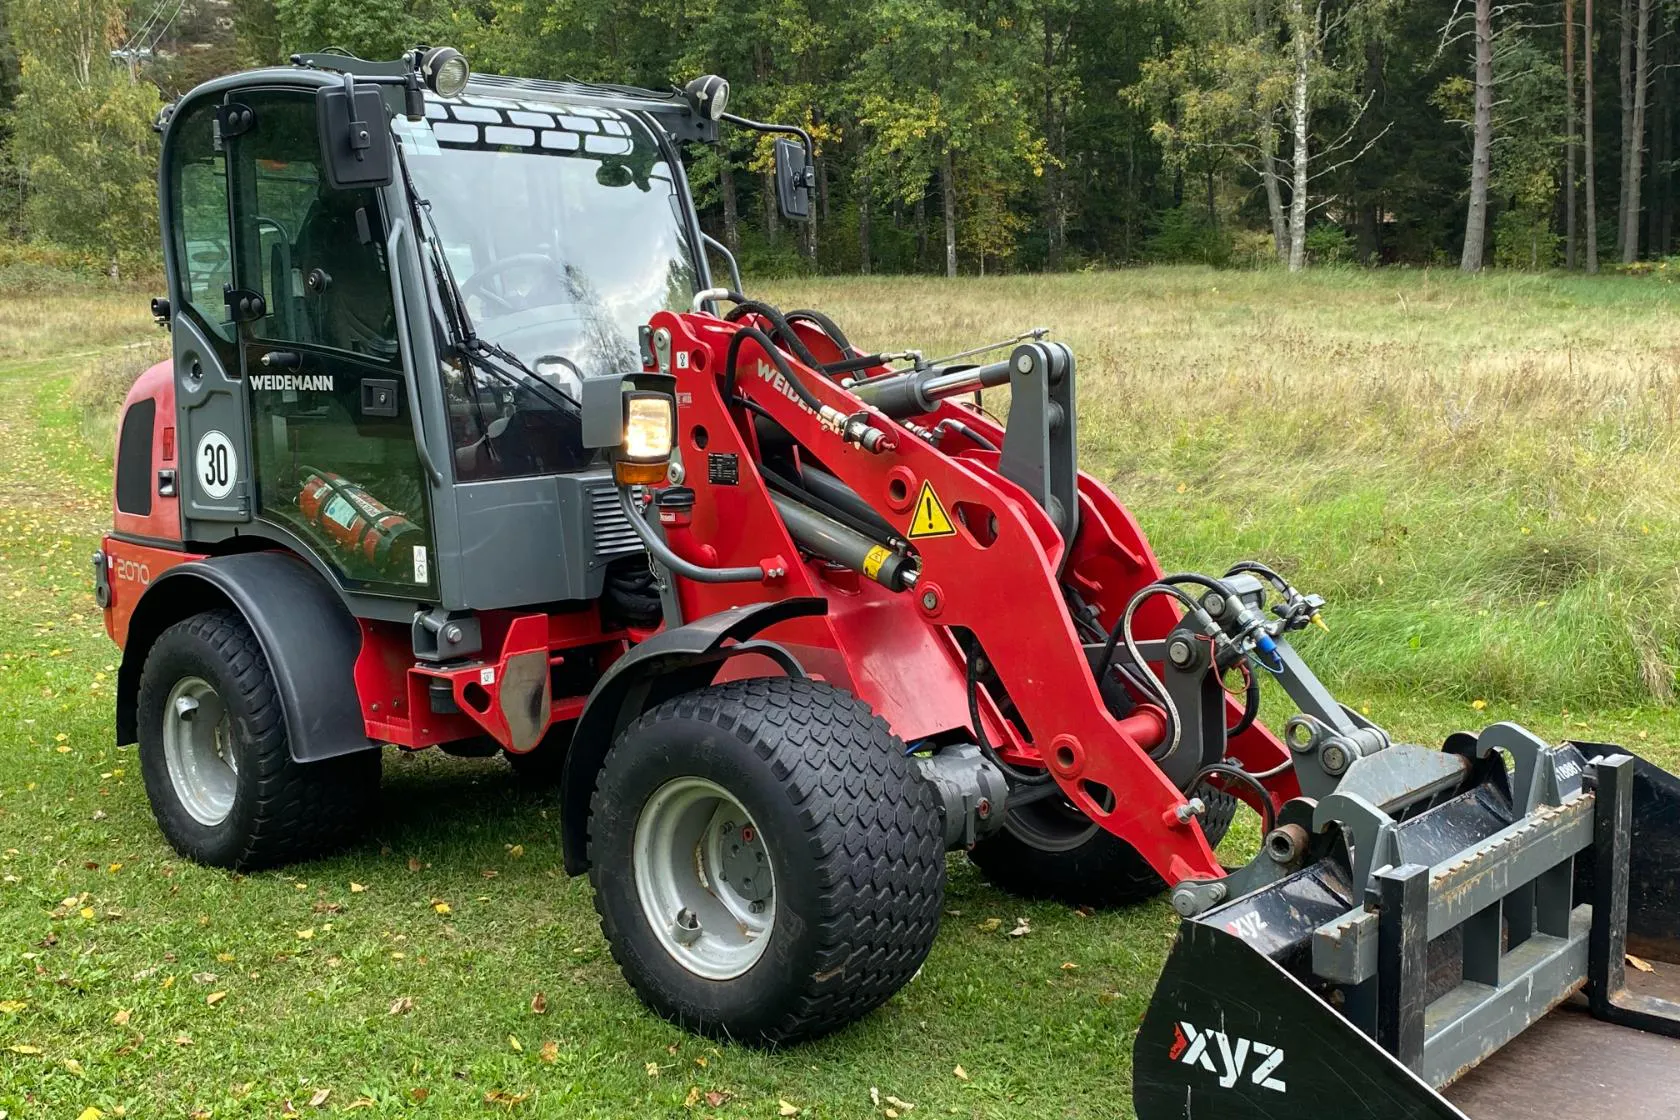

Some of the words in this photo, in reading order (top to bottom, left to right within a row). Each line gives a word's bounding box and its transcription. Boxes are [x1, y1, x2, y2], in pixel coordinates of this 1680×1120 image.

[249, 374, 334, 391] WEIDEMANN
[204, 443, 229, 487] 30
[117, 558, 150, 585] 2070
